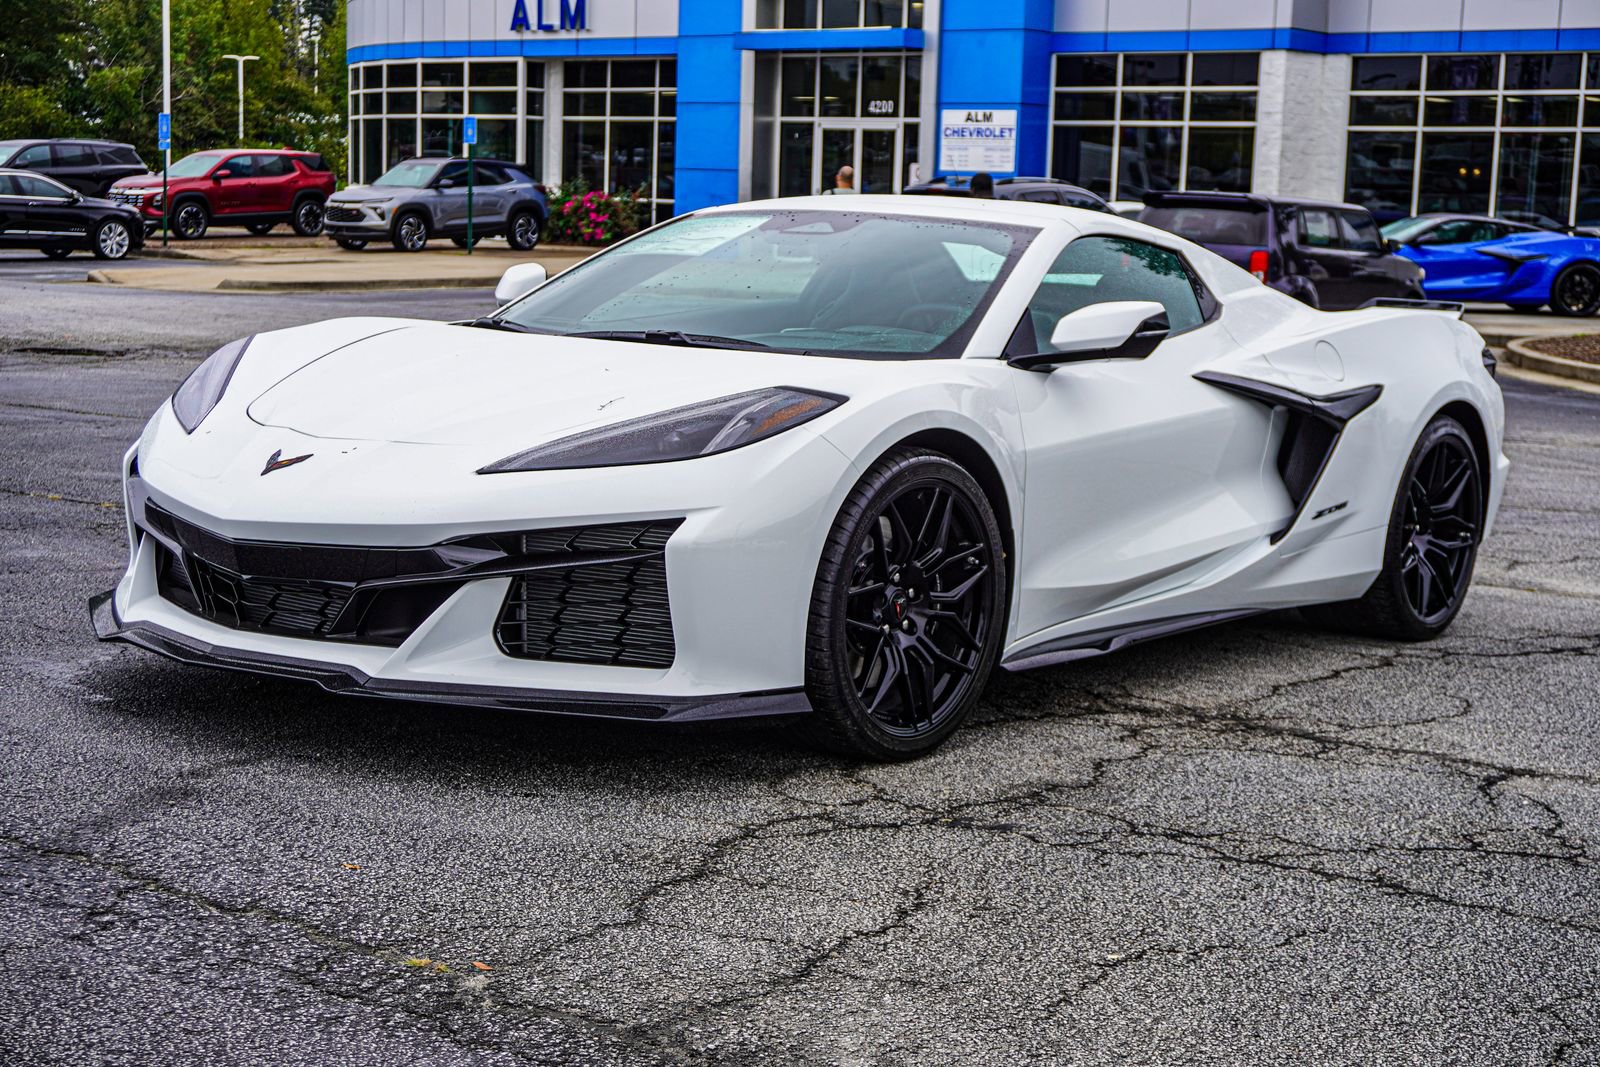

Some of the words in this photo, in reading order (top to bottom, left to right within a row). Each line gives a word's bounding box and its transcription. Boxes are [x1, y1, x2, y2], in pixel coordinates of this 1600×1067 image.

[511, 0, 586, 31] ALM
[868, 100, 894, 112] 4200
[965, 112, 993, 122] ALM
[944, 127, 1014, 138] CHEVROLET
